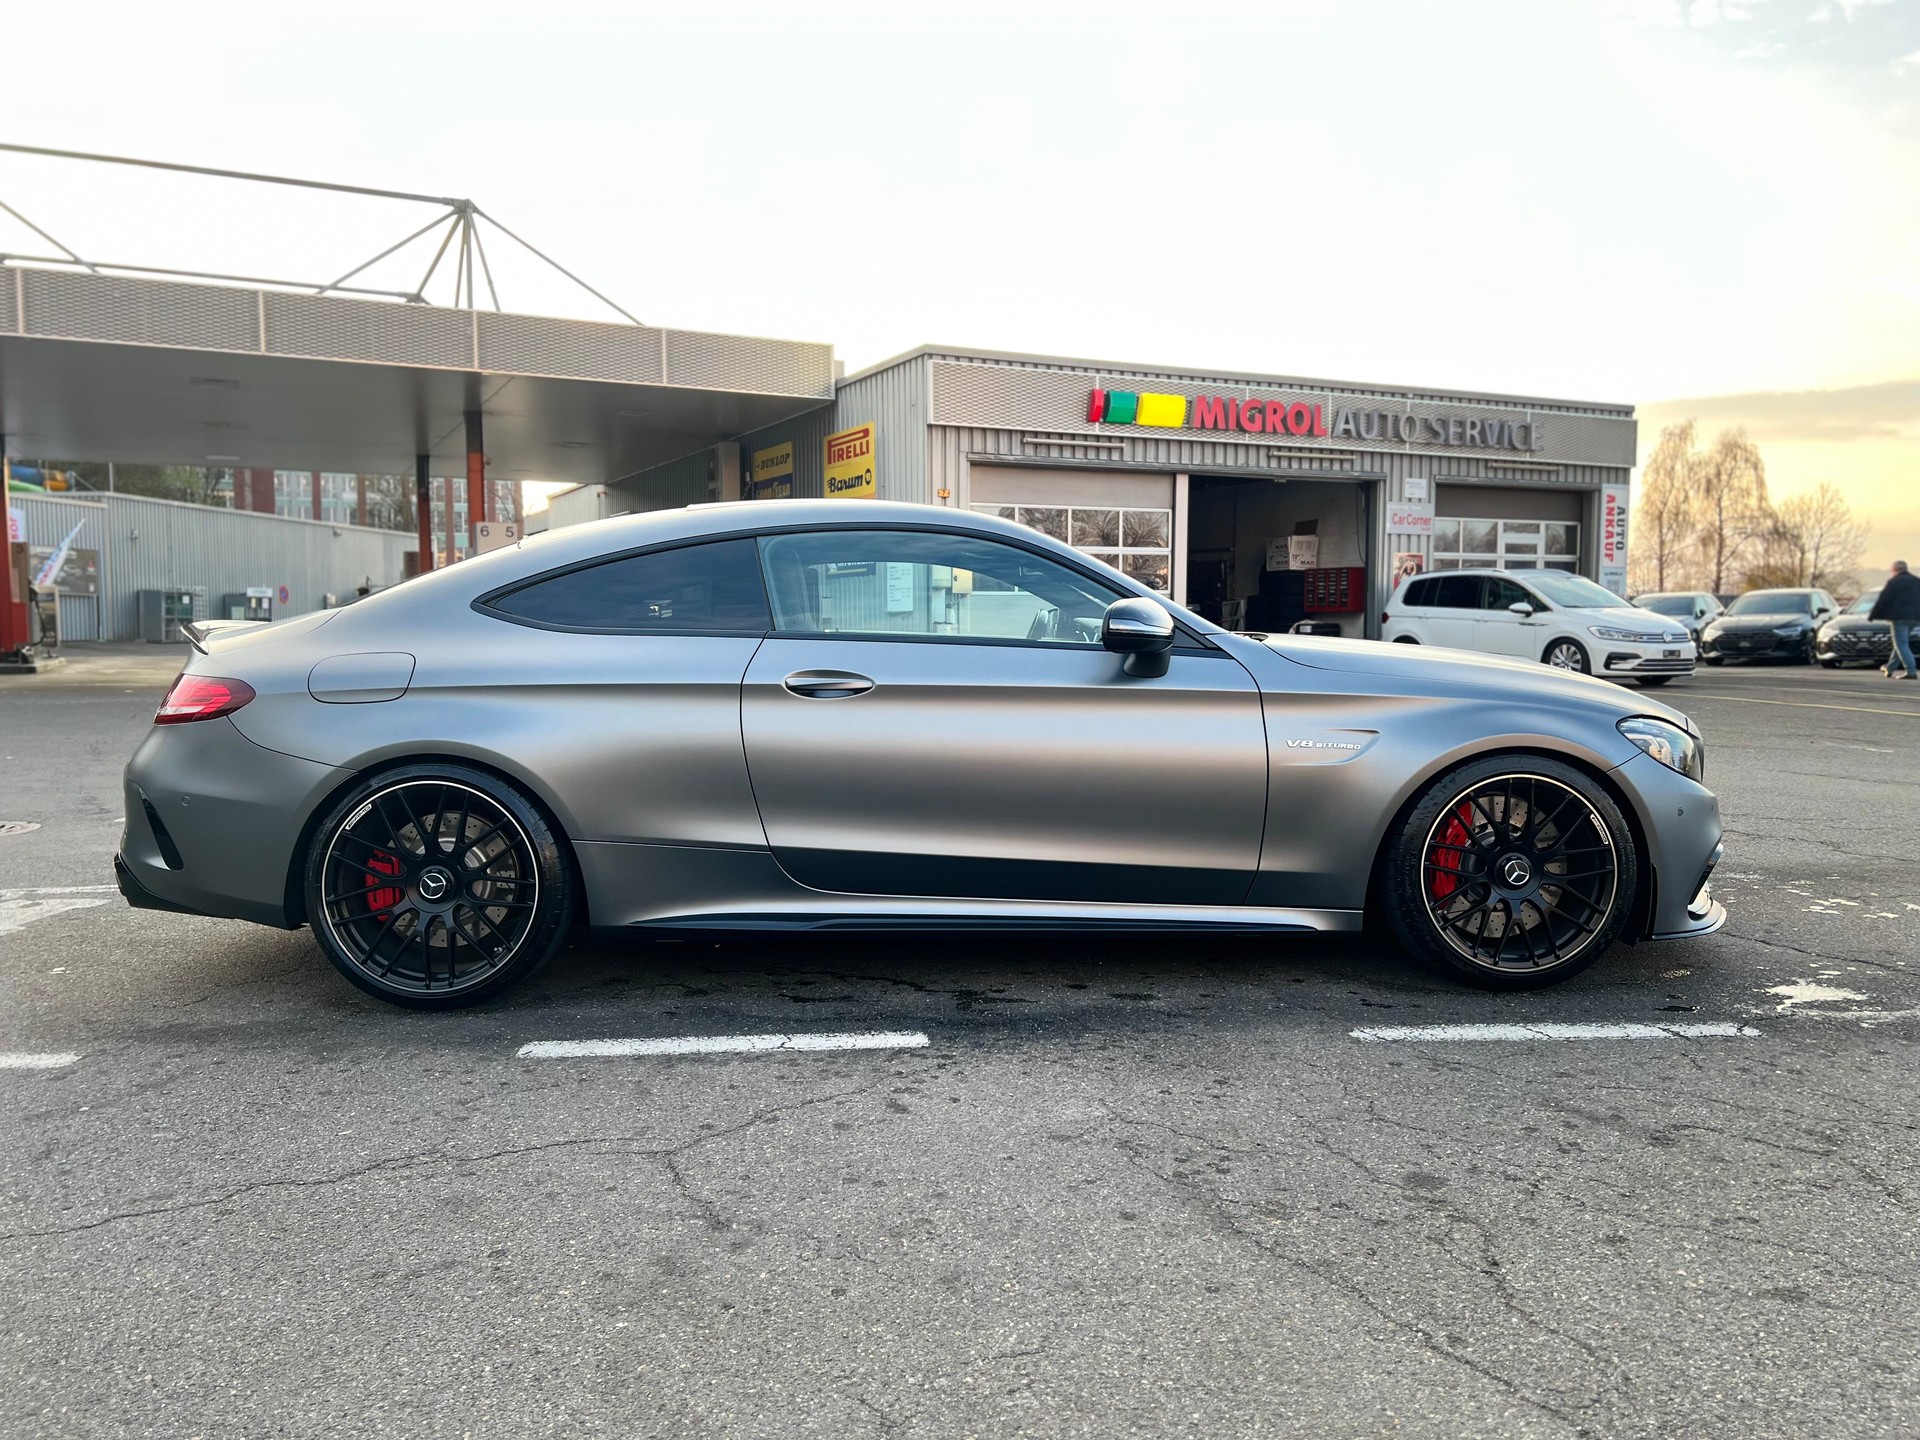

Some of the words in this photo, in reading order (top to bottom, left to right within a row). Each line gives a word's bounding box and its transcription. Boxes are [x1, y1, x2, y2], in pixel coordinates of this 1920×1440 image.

[1193, 394, 1328, 437] MIGROL
[1333, 407, 1420, 442] AUTO
[1427, 414, 1544, 450] SERVICE
[827, 427, 870, 465] PIRELLI
[760, 453, 790, 470] DUNLOP
[827, 474, 864, 493] Barum
[480, 525, 490, 537] 6
[505, 526, 514, 538] 5
[1604, 494, 1616, 562] ANKAUF
[1615, 505, 1626, 551] AUTO
[1286, 739, 1314, 748] V8
[1315, 742, 1361, 750] BITURBO
